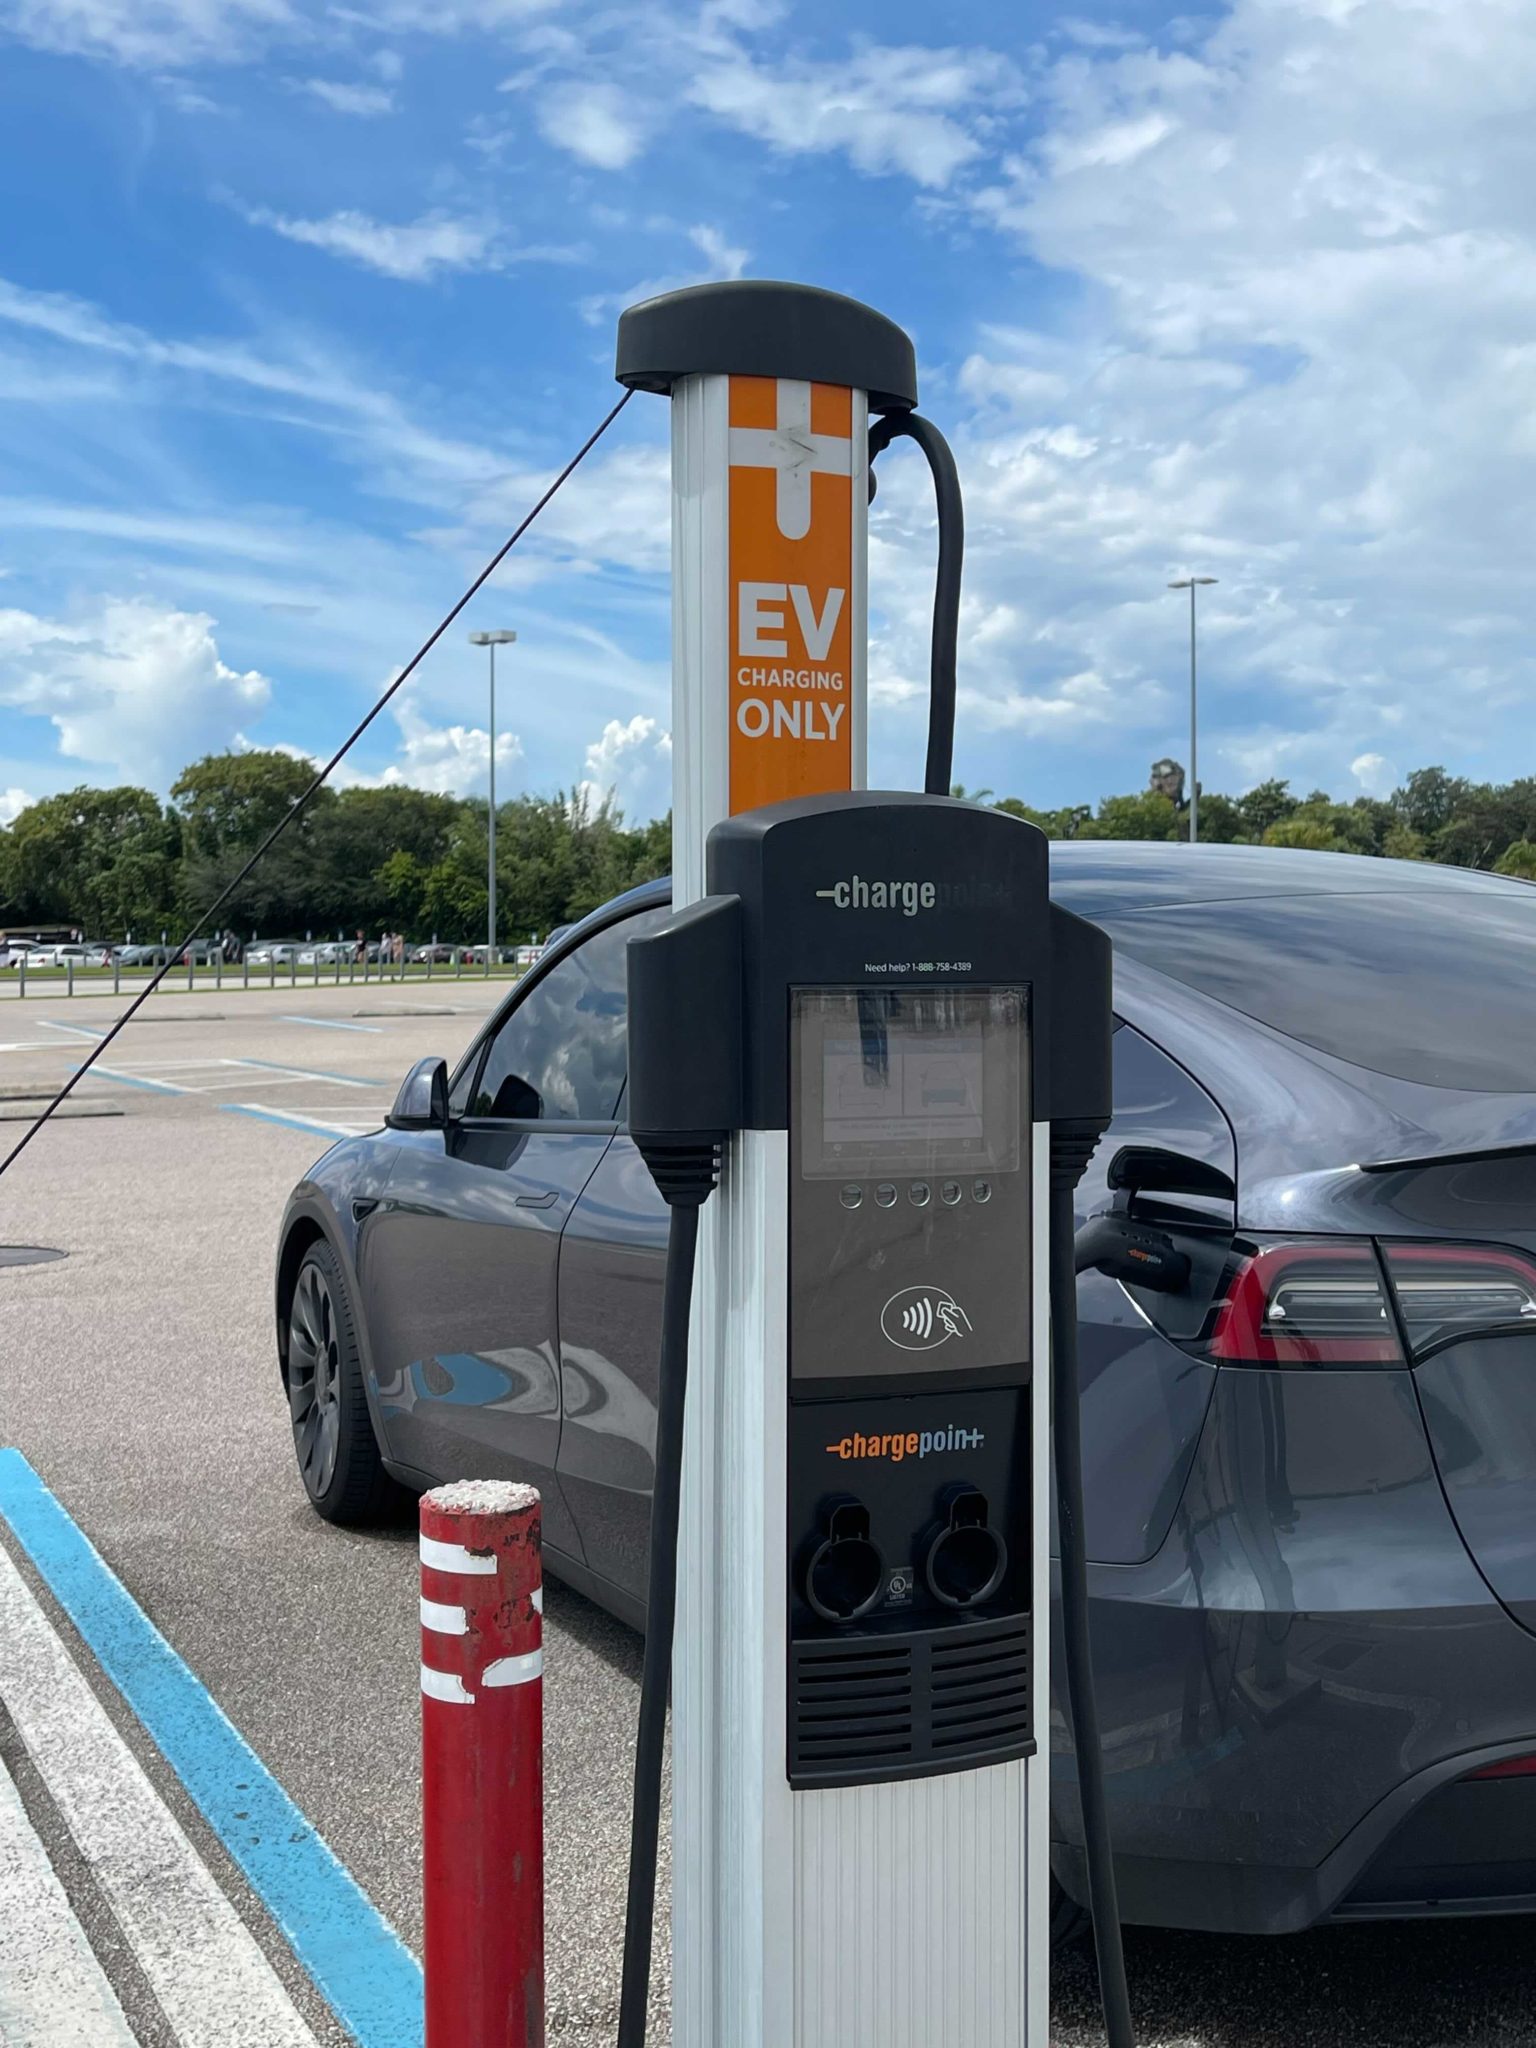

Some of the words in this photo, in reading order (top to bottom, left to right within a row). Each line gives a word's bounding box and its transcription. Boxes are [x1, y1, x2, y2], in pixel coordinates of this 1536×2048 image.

[738, 581, 846, 661] EV
[737, 667, 843, 690] CHARGING
[737, 698, 845, 741] ONLY
[864, 962, 887, 972] Need
[888, 962, 911, 973] help?
[912, 961, 972, 972] 1-888-758-4389
